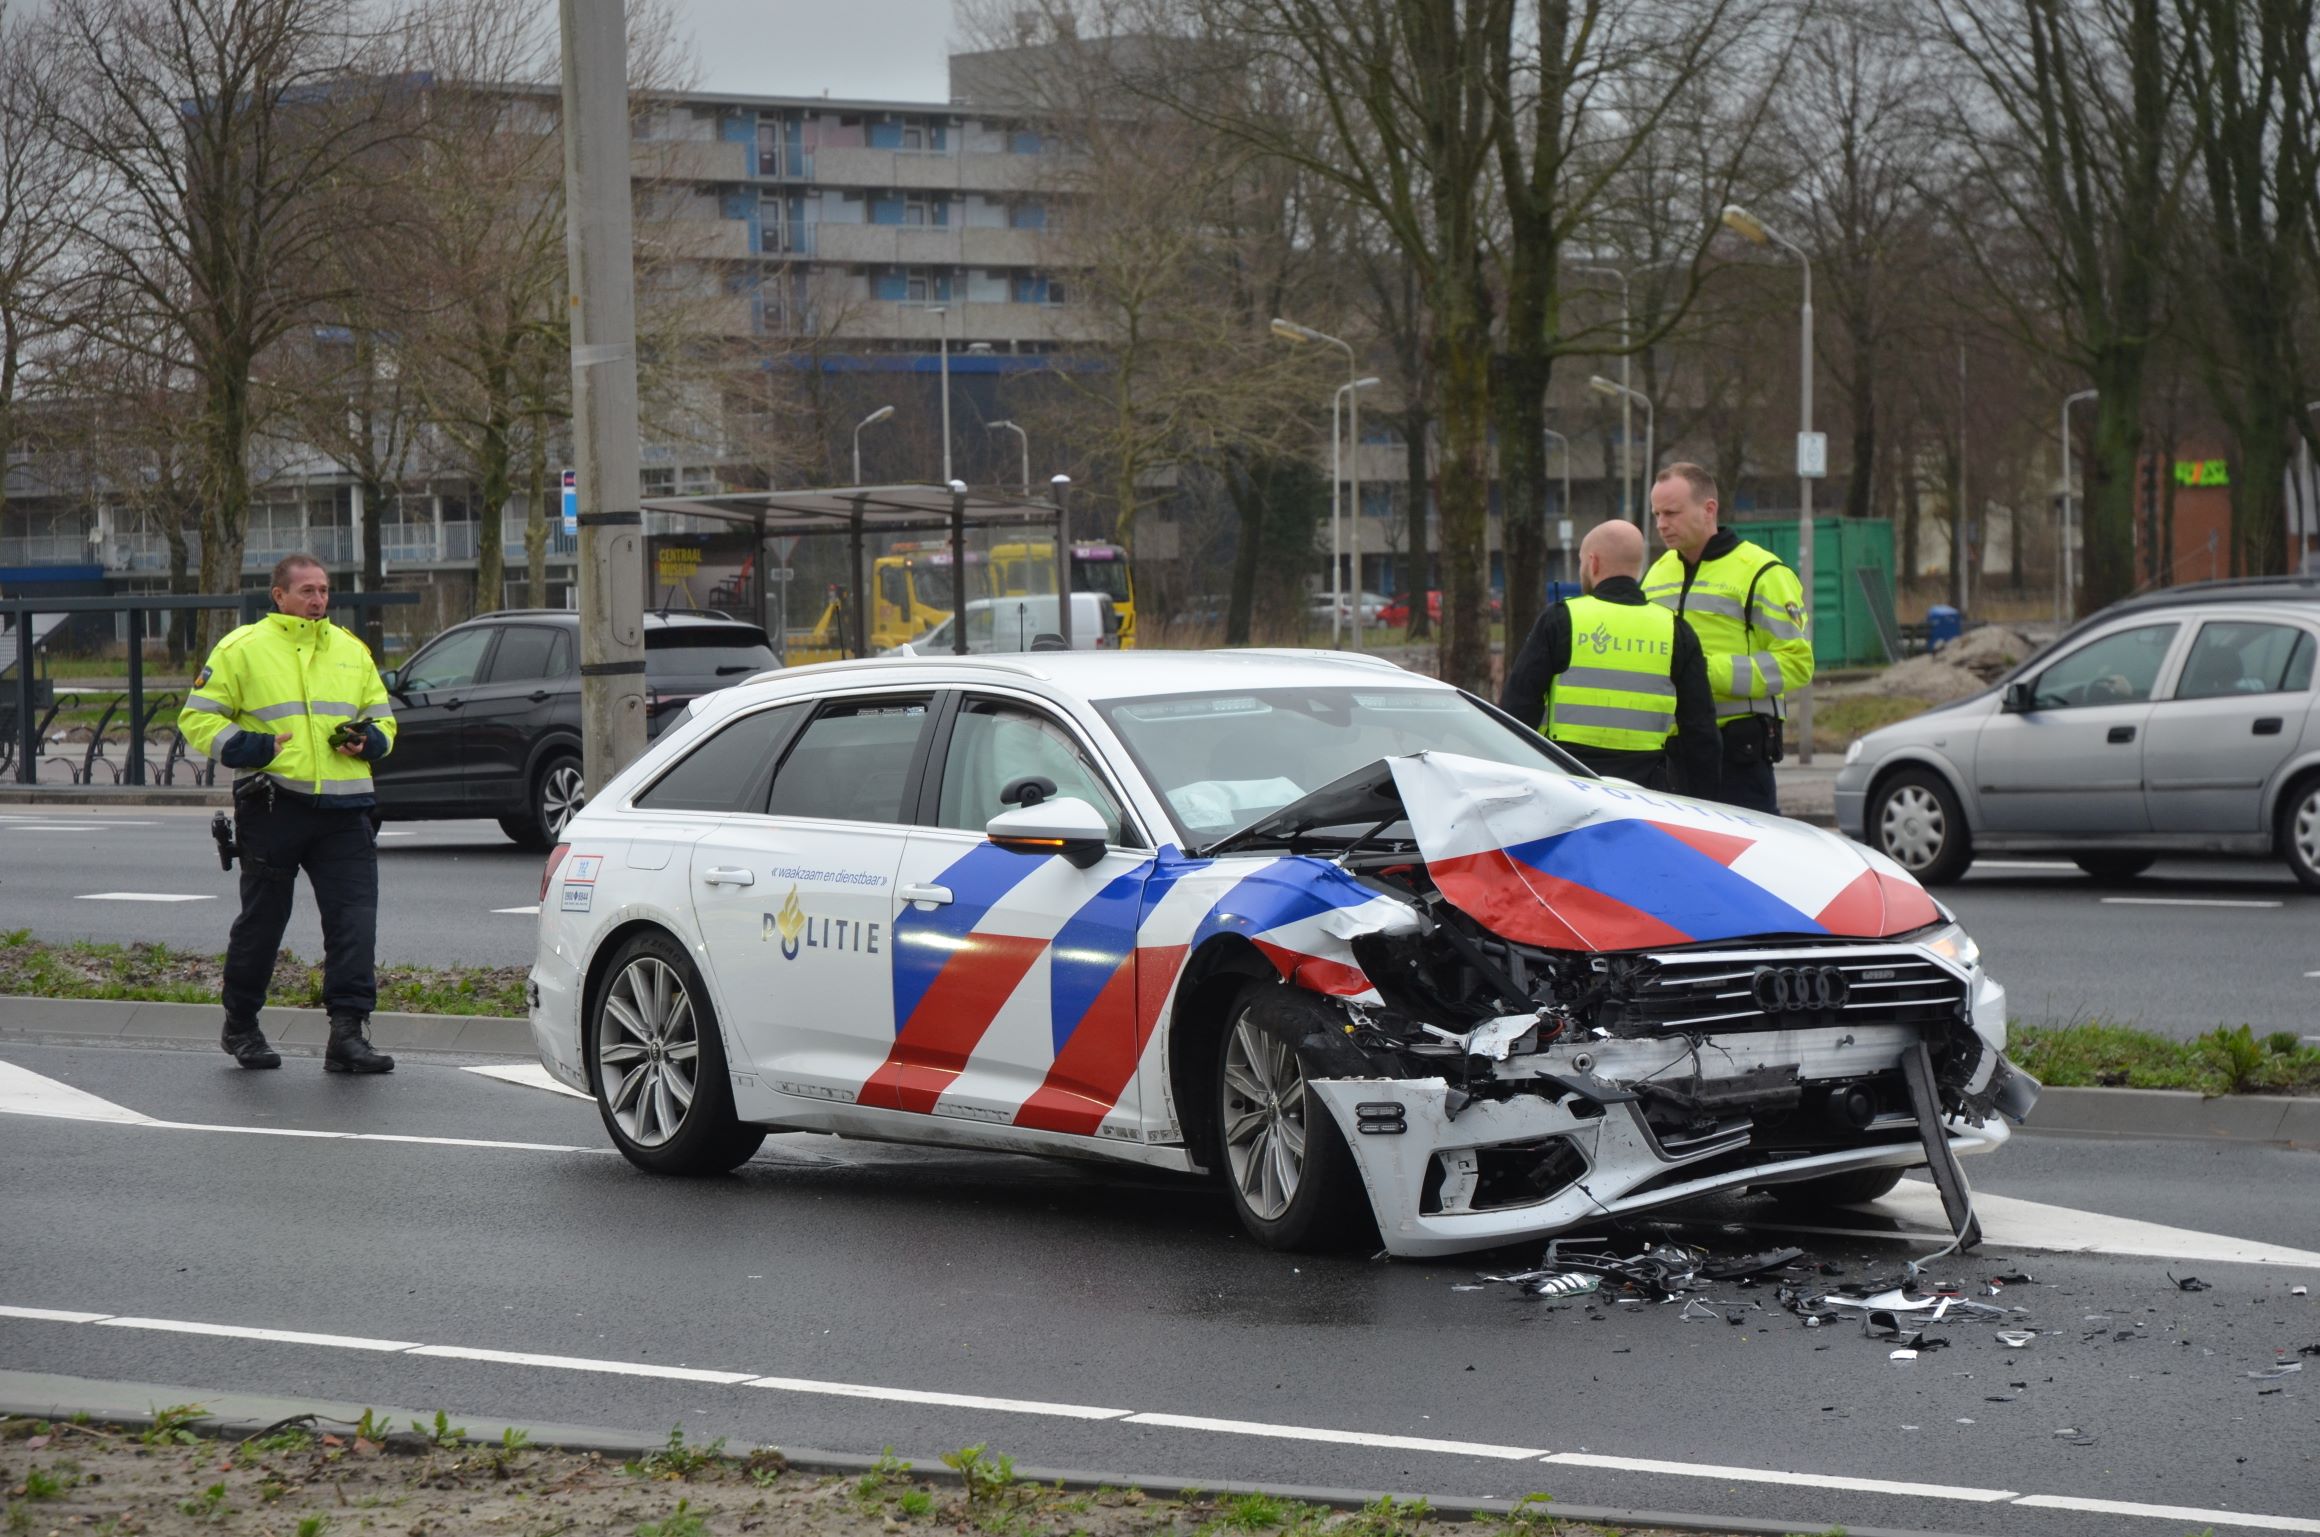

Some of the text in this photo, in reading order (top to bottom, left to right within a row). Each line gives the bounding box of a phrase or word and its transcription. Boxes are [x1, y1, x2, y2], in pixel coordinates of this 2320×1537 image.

[659, 548, 702, 562] CENTRAAL
[1578, 631, 1668, 655] POLITIE
[1567, 779, 1766, 829] POLITIE
[778, 866, 824, 881] waakzaam
[824, 871, 836, 882] en
[836, 869, 881, 886] dienstbaar
[762, 911, 880, 960] POLITIE
